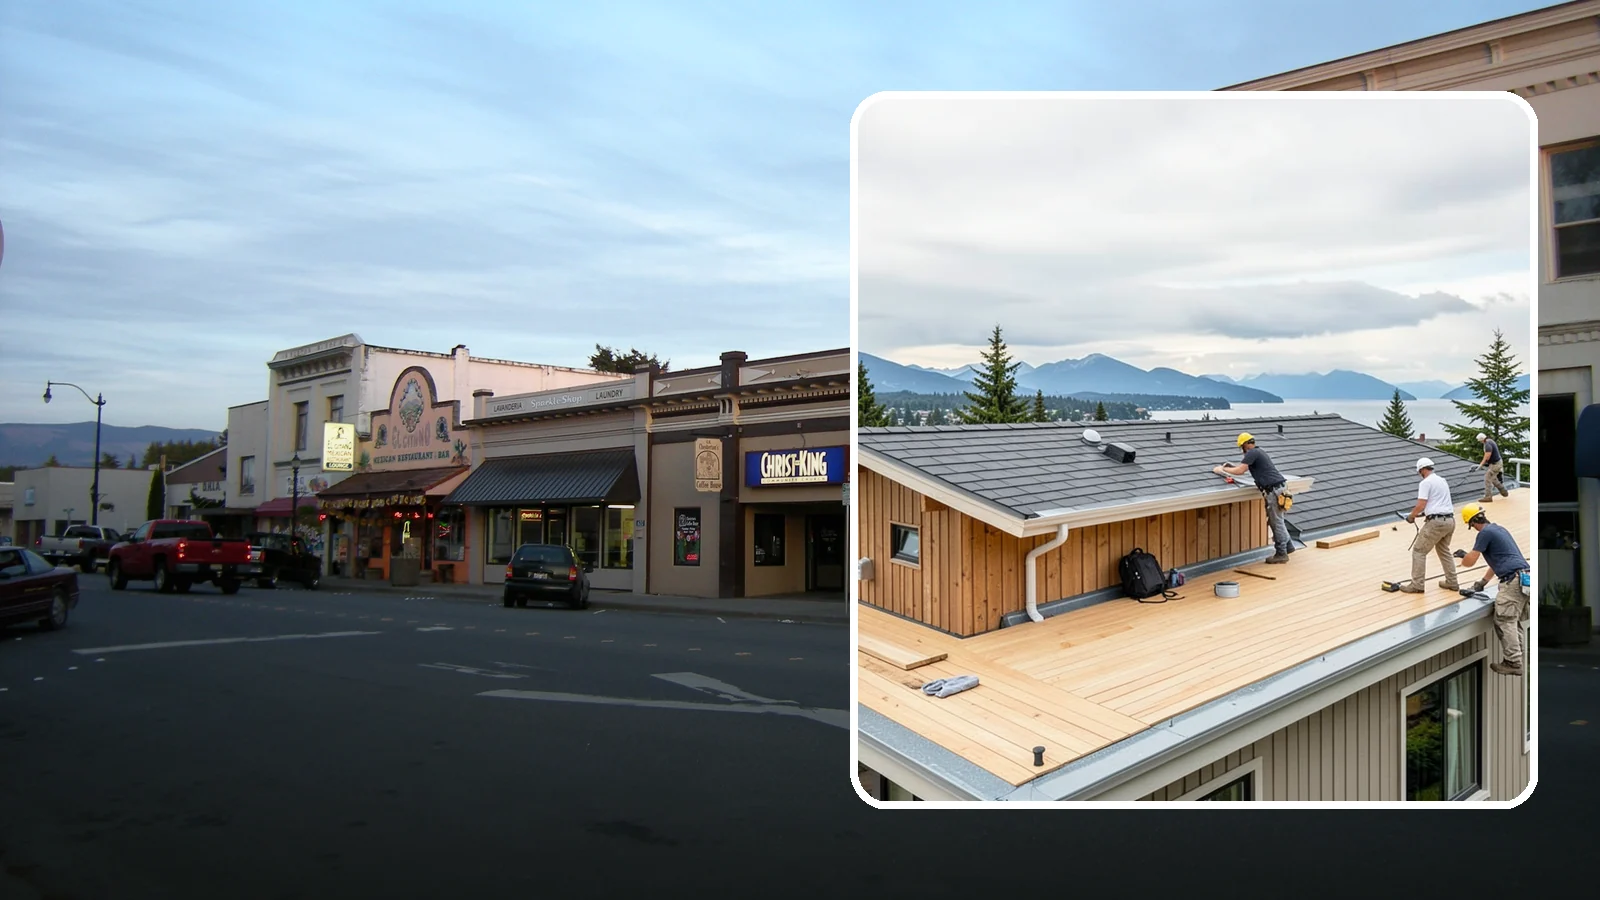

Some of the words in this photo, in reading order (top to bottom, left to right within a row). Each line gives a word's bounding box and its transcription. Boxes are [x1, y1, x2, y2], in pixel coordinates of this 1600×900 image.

[493, 402, 523, 412] LAVANDERIA
[531, 399, 560, 409] Sparkle
[562, 394, 582, 404] Shop
[595, 389, 623, 400] LAUNDRY
[373, 454, 396, 464] MEXICAN
[397, 451, 433, 462] RESTAURANT
[438, 450, 450, 459] BAR
[761, 452, 797, 478] CHRIST
[799, 450, 827, 476] KING
